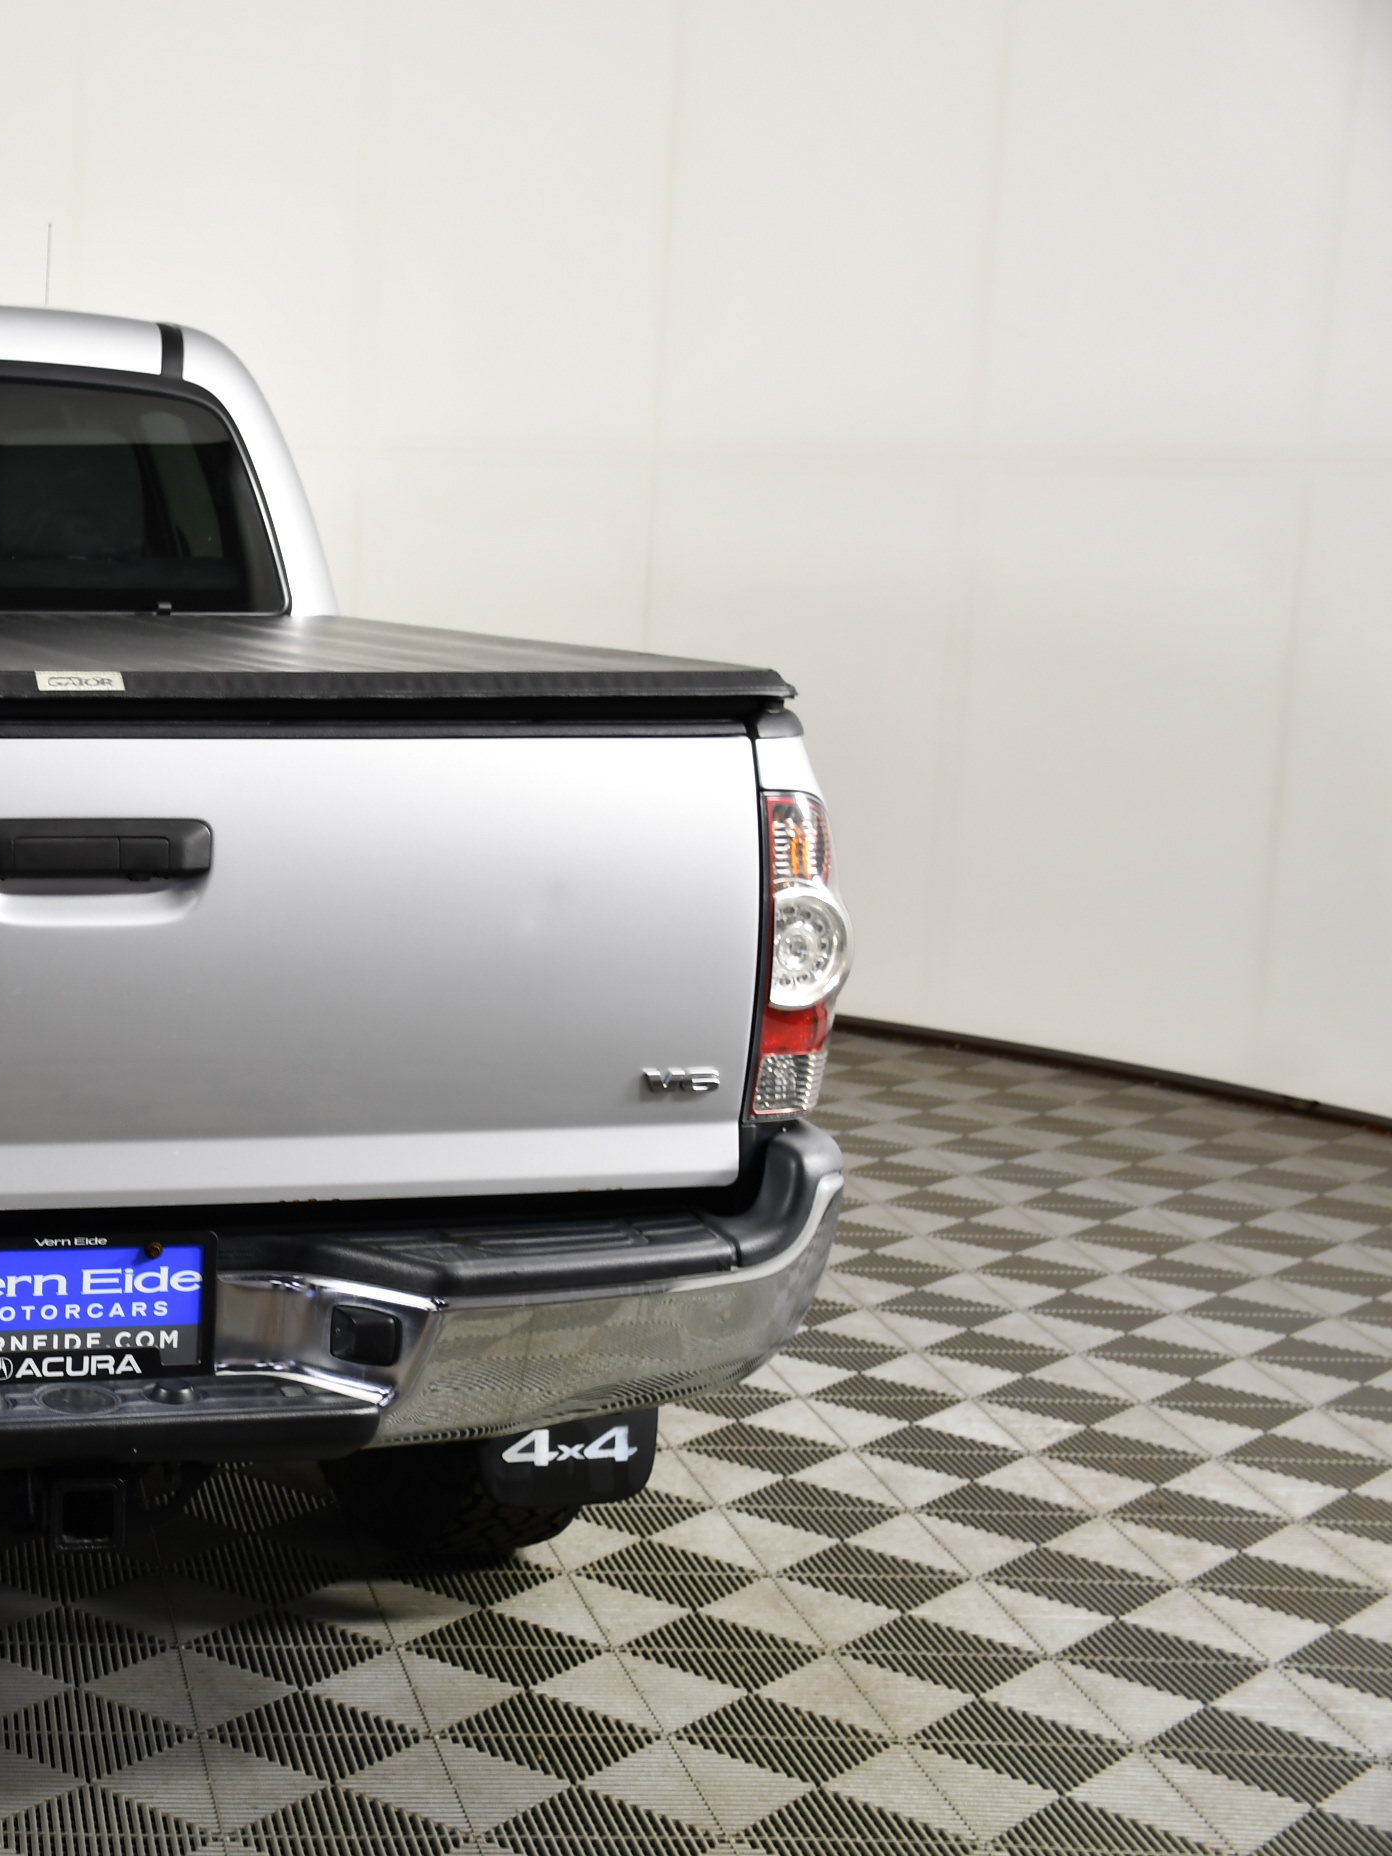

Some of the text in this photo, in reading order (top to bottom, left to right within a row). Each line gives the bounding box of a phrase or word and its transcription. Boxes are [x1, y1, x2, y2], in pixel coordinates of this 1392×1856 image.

[640, 1067, 721, 1094] V6
[34, 1235, 108, 1247] Vern Eide
[80, 1266, 203, 1295] Eide
[15, 1353, 142, 1378] ACURA
[501, 1425, 638, 1467] 4x4
